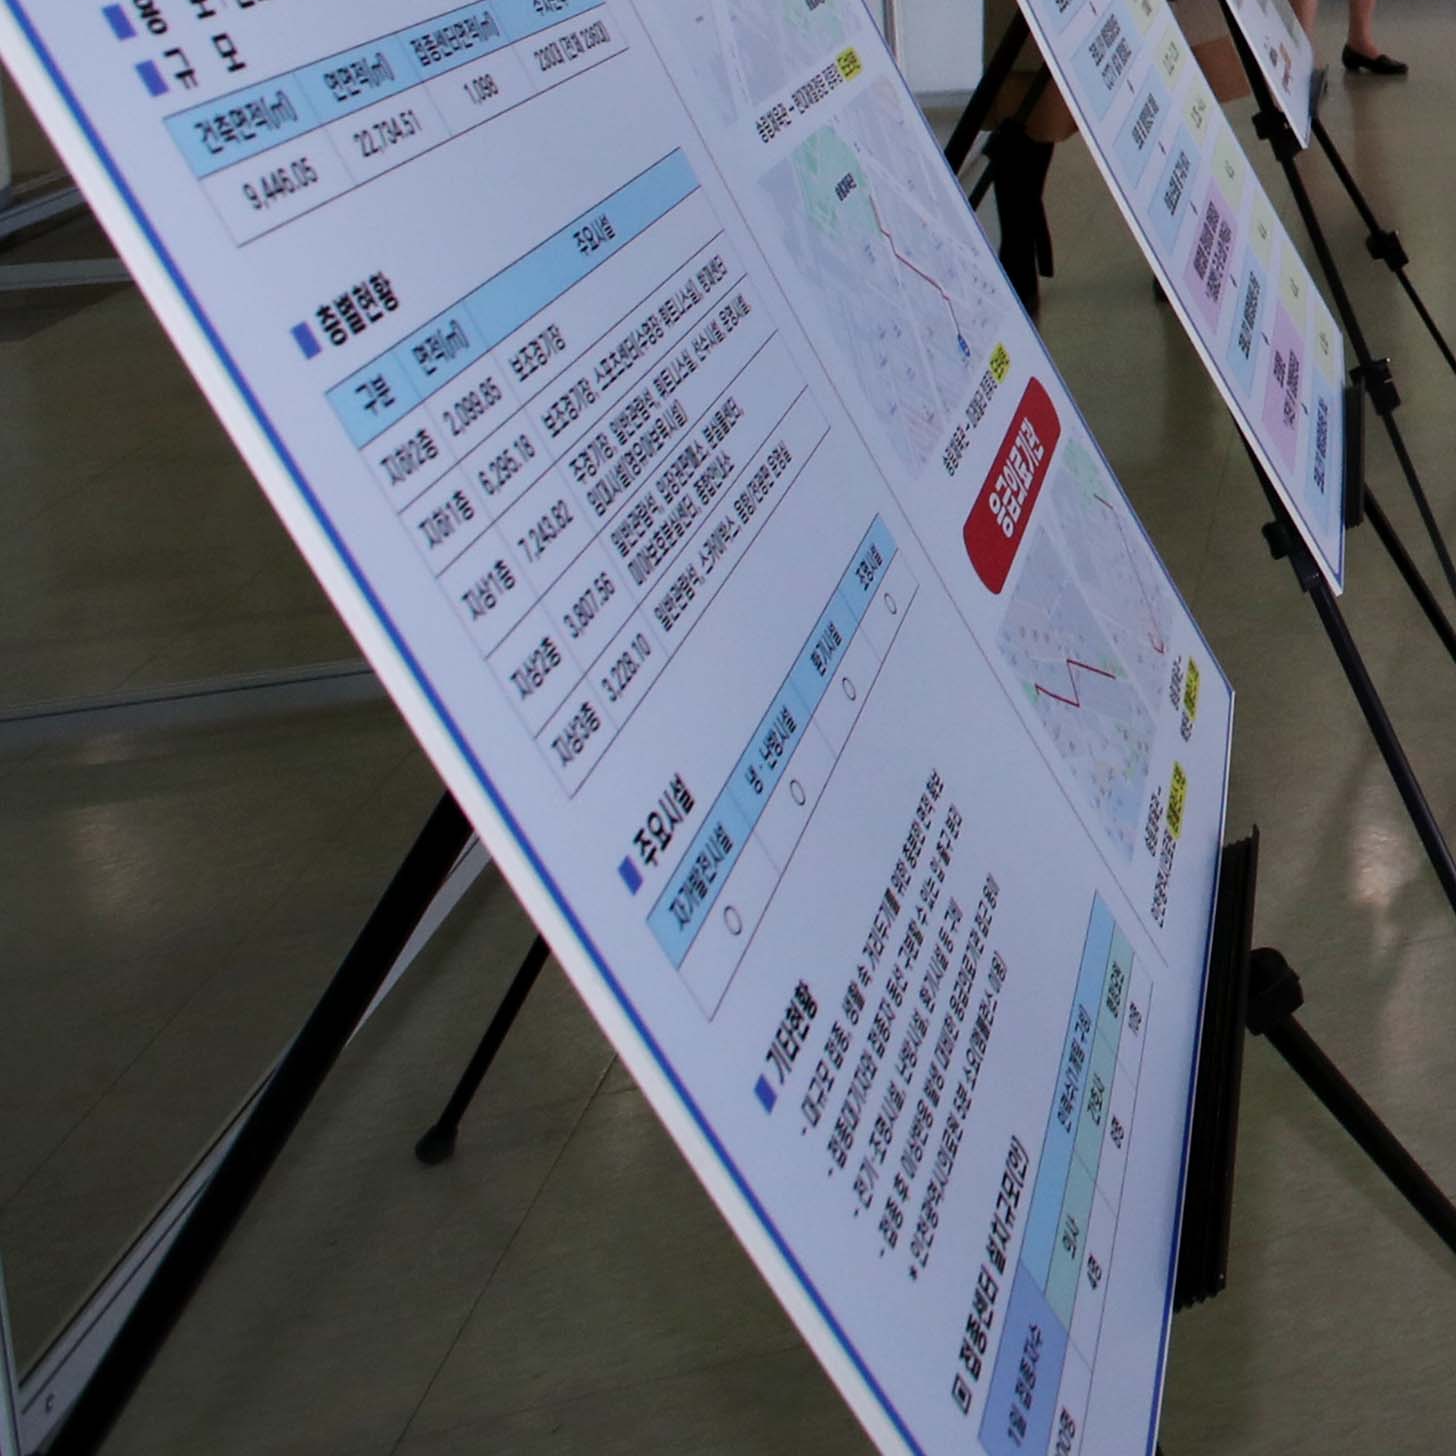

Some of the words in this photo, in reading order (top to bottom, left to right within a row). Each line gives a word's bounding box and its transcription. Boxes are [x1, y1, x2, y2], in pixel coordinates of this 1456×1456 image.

[163, 47, 197, 89] 규
[211, 32, 246, 72] 모
[242, 157, 318, 210] 9,446.05
[353, 109, 421, 158] 22,734.51
[463, 73, 499, 104] 1,098
[316, 273, 398, 346] 층별현황
[354, 375, 395, 410] 구분
[572, 215, 616, 255] 주요시설
[380, 428, 439, 485] 지하2층
[442, 376, 502, 436] 2,099.85
[510, 324, 566, 382] 보조경기장
[418, 490, 474, 547] 지하1층
[478, 433, 535, 495] 6,295.18
[989, 417, 1044, 537] 응급의료기관
[461, 559, 516, 619] 지상1층
[517, 499, 574, 561] 7,243.82
[510, 636, 561, 698] 지상2층
[563, 571, 615, 639] 3,807.56
[551, 701, 600, 765] 지상3층
[601, 632, 651, 702] 3,228.10
[668, 823, 733, 929] 자가발전시설
[759, 706, 797, 770] 난방시설
[809, 621, 842, 677] 환기시설
[855, 544, 883, 591] 조명시설
[633, 774, 694, 865] 주요시설
[765, 980, 818, 1083] 기타현황
[827, 1050, 878, 1168] 접종대기자와
[866, 997, 895, 1059] 접종자
[915, 905, 928, 926] 수
[918, 943, 949, 1014] 환기시설
[800, 1059, 835, 1128] 대규모
[878, 1196, 904, 1249] 접종
[959, 1265, 998, 1381] 접종센터
[986, 1135, 1029, 1275] 설치규모(안)
